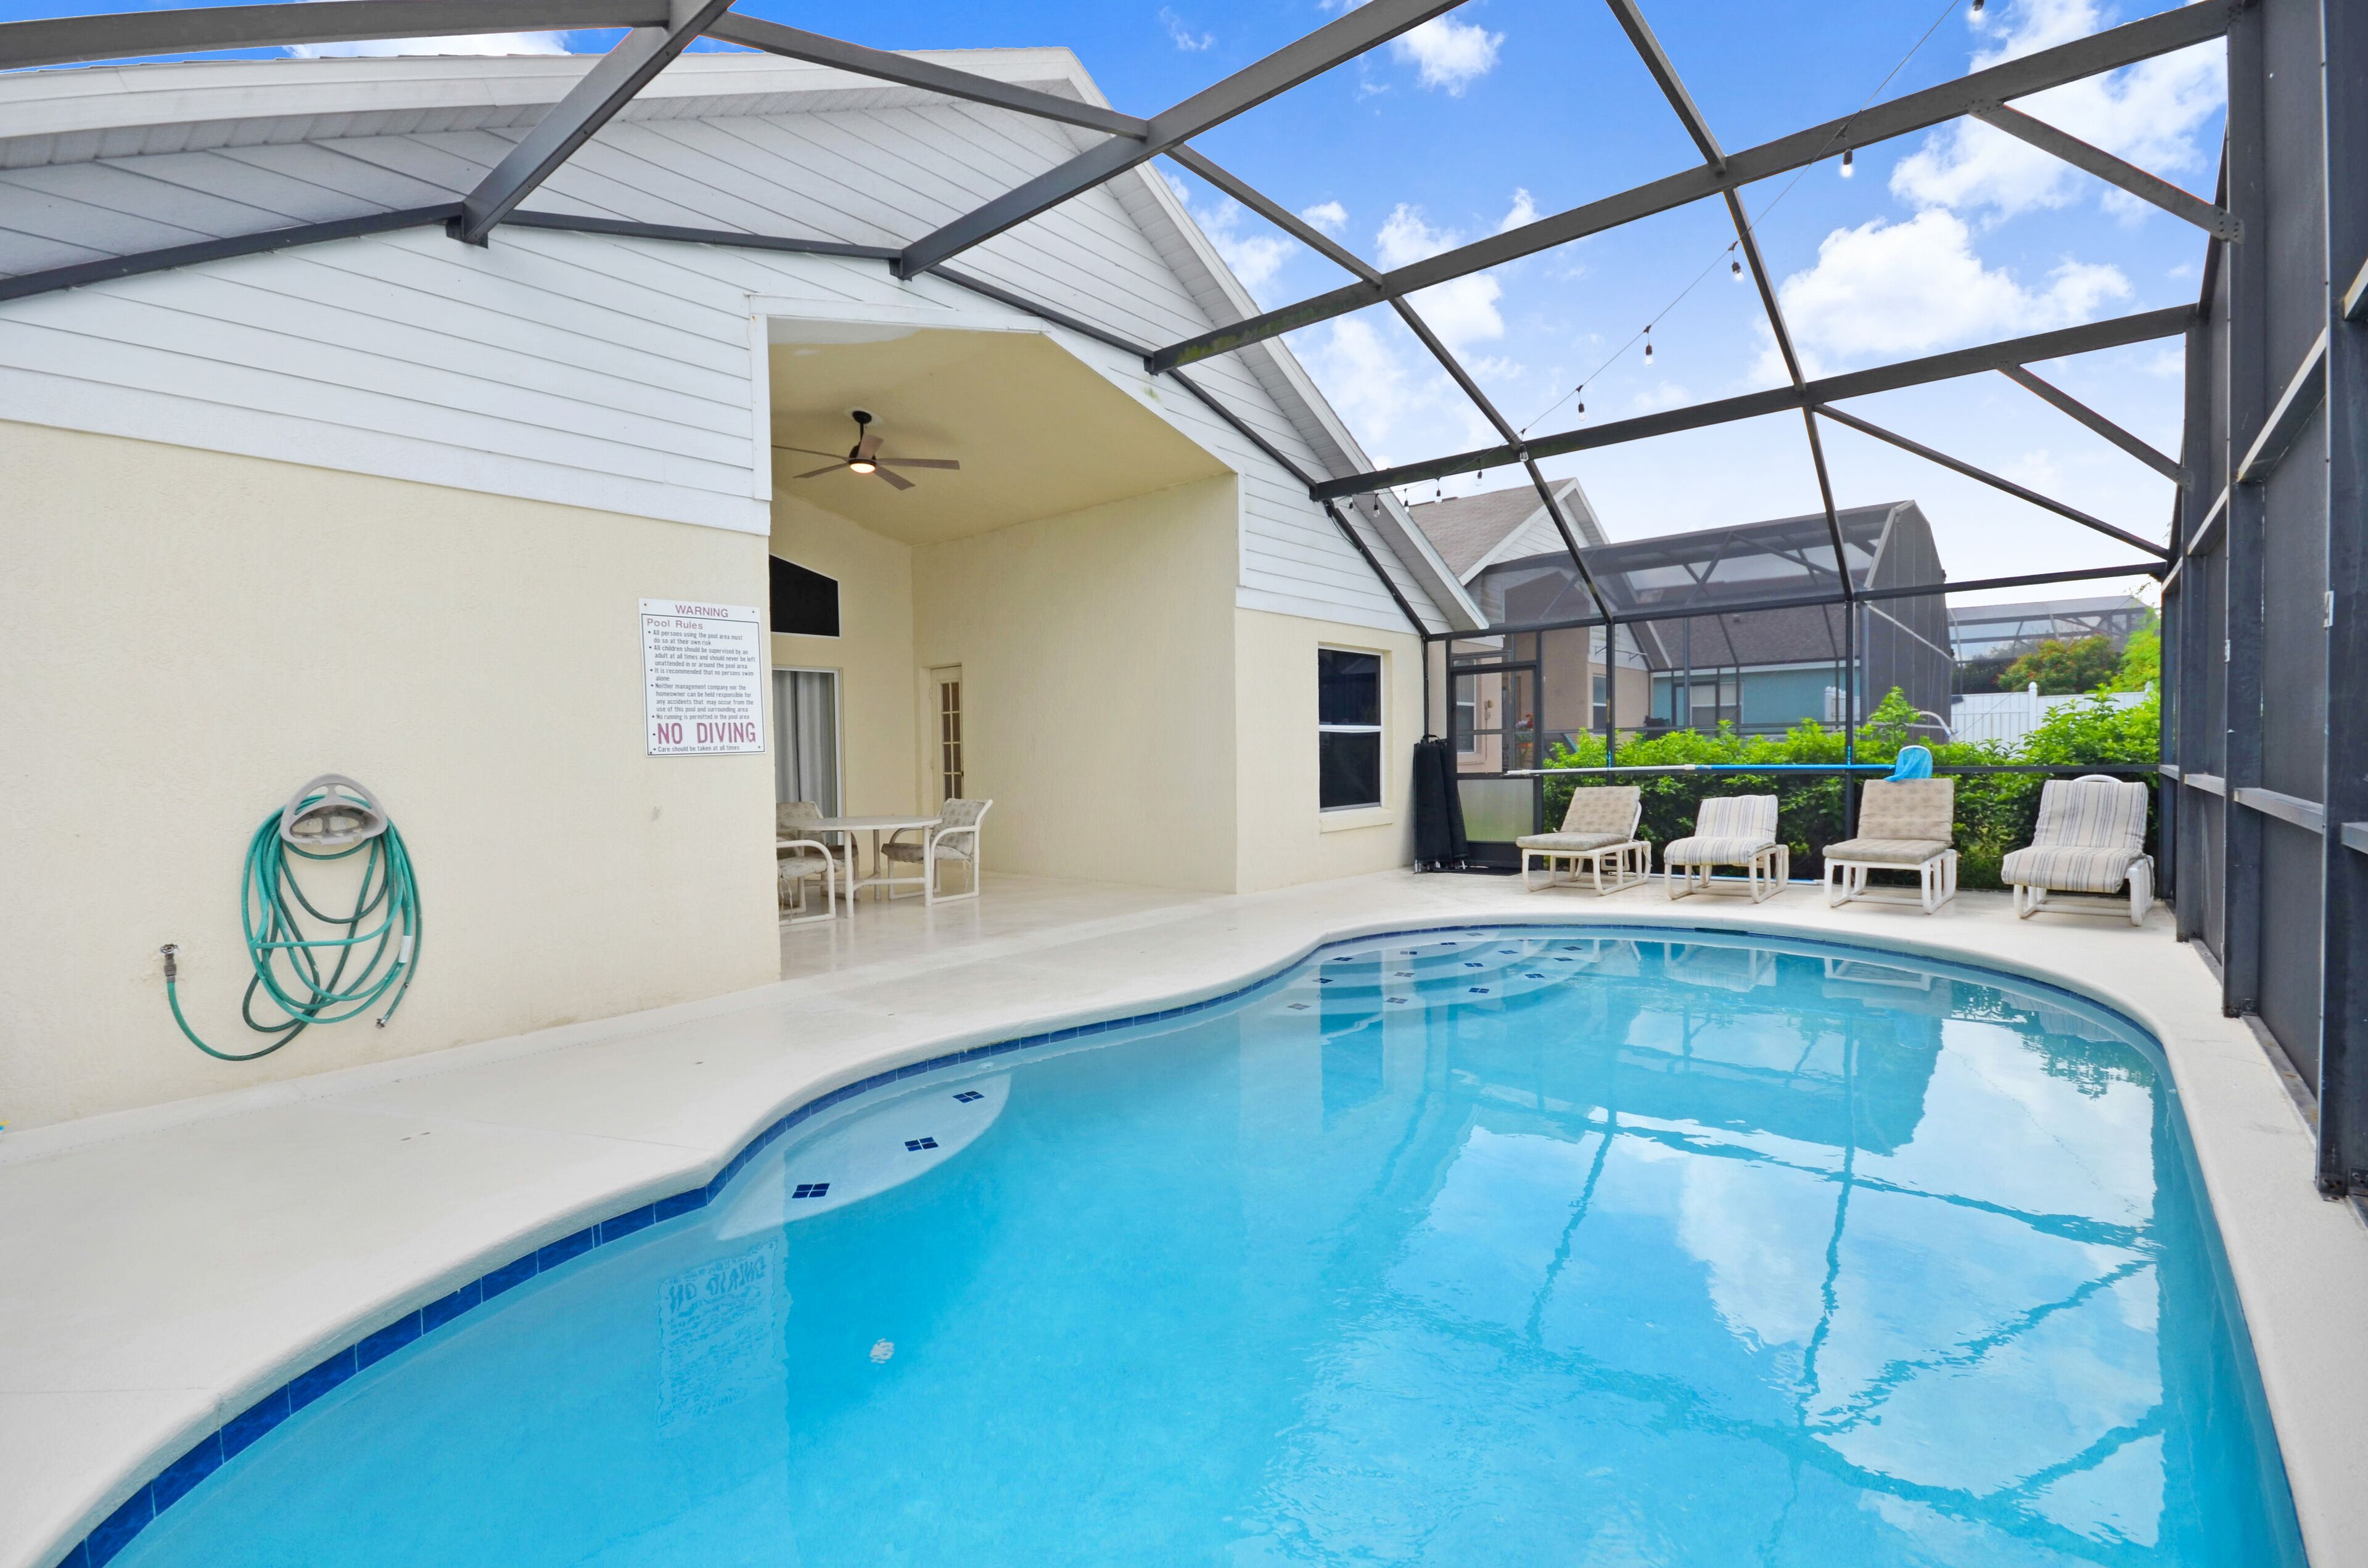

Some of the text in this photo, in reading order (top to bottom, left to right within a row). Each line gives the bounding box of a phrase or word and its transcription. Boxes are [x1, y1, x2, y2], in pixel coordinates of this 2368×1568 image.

[675, 604, 728, 617] WARNING
[647, 618, 703, 630] Pool Rules
[657, 722, 755, 745] NO DIVING
